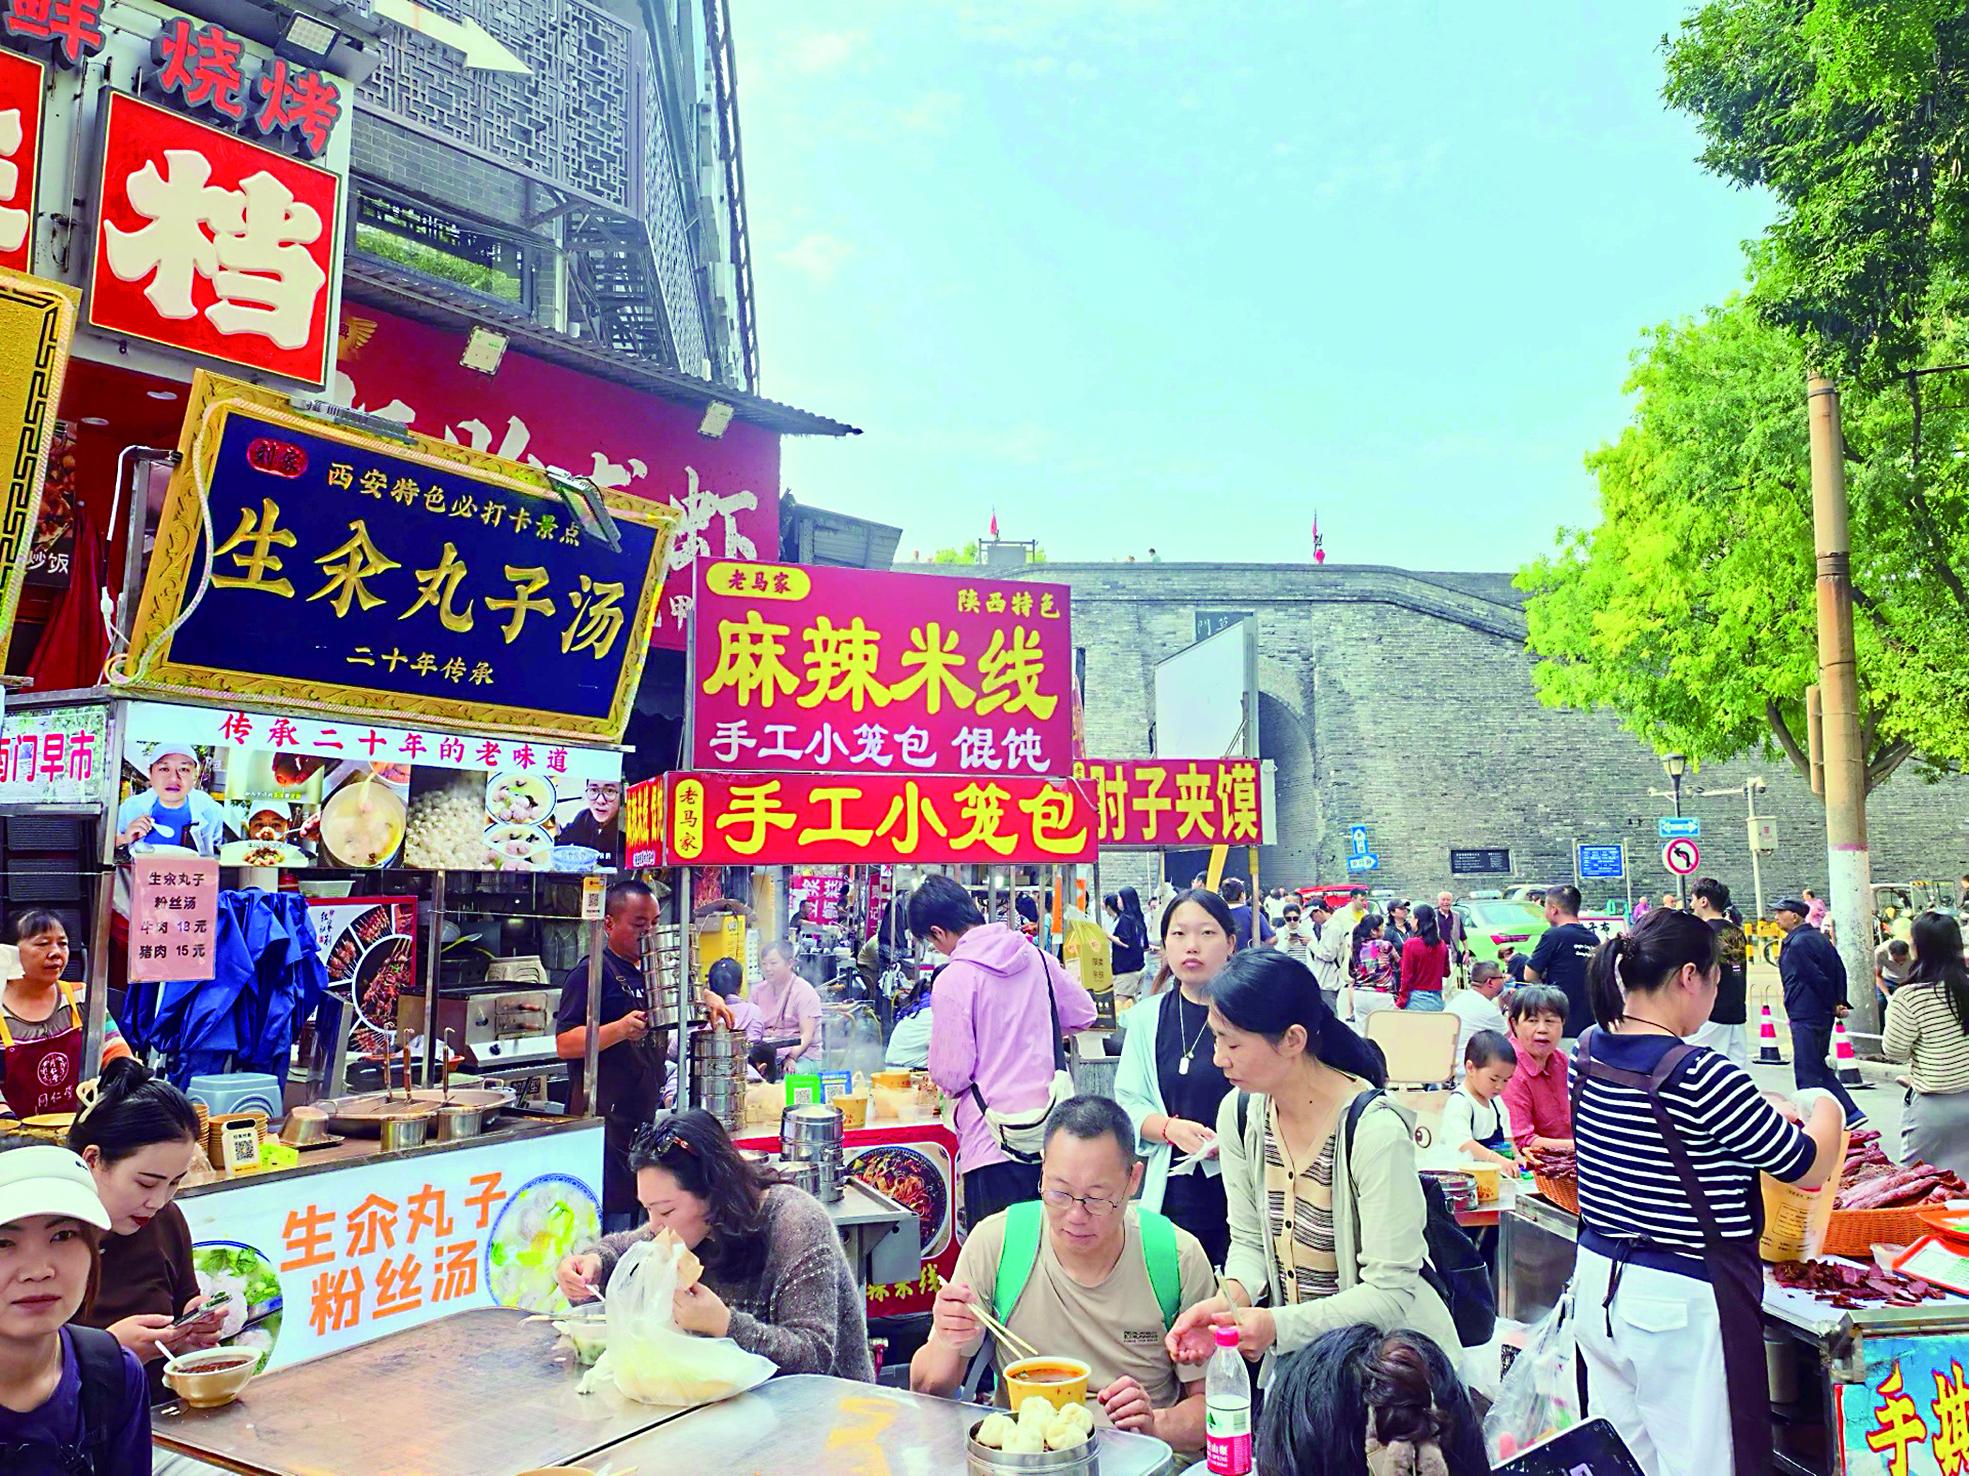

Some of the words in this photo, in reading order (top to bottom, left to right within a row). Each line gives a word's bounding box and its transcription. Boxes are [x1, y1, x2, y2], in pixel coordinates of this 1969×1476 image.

[161, 19, 340, 154] 烧烤
[328, 463, 580, 547] 西安特色必打卡景点
[727, 568, 792, 594] 老马家
[957, 588, 1061, 620] 陕西特色
[346, 647, 494, 685] 二十年传承
[702, 610, 1059, 720] 麻辣米线
[218, 711, 569, 774] 传承二十年的老味道
[709, 719, 938, 768] 手工小笼包
[951, 726, 1051, 771] 馄饨
[678, 786, 699, 852] 老马家
[715, 779, 1088, 855] 手工小笼包
[1089, 762, 1259, 841] 肘子夹馍
[154, 895, 197, 910] 粉丝汤
[139, 944, 167, 960] 猪肉
[308, 1239, 479, 1337] 粉丝汤
